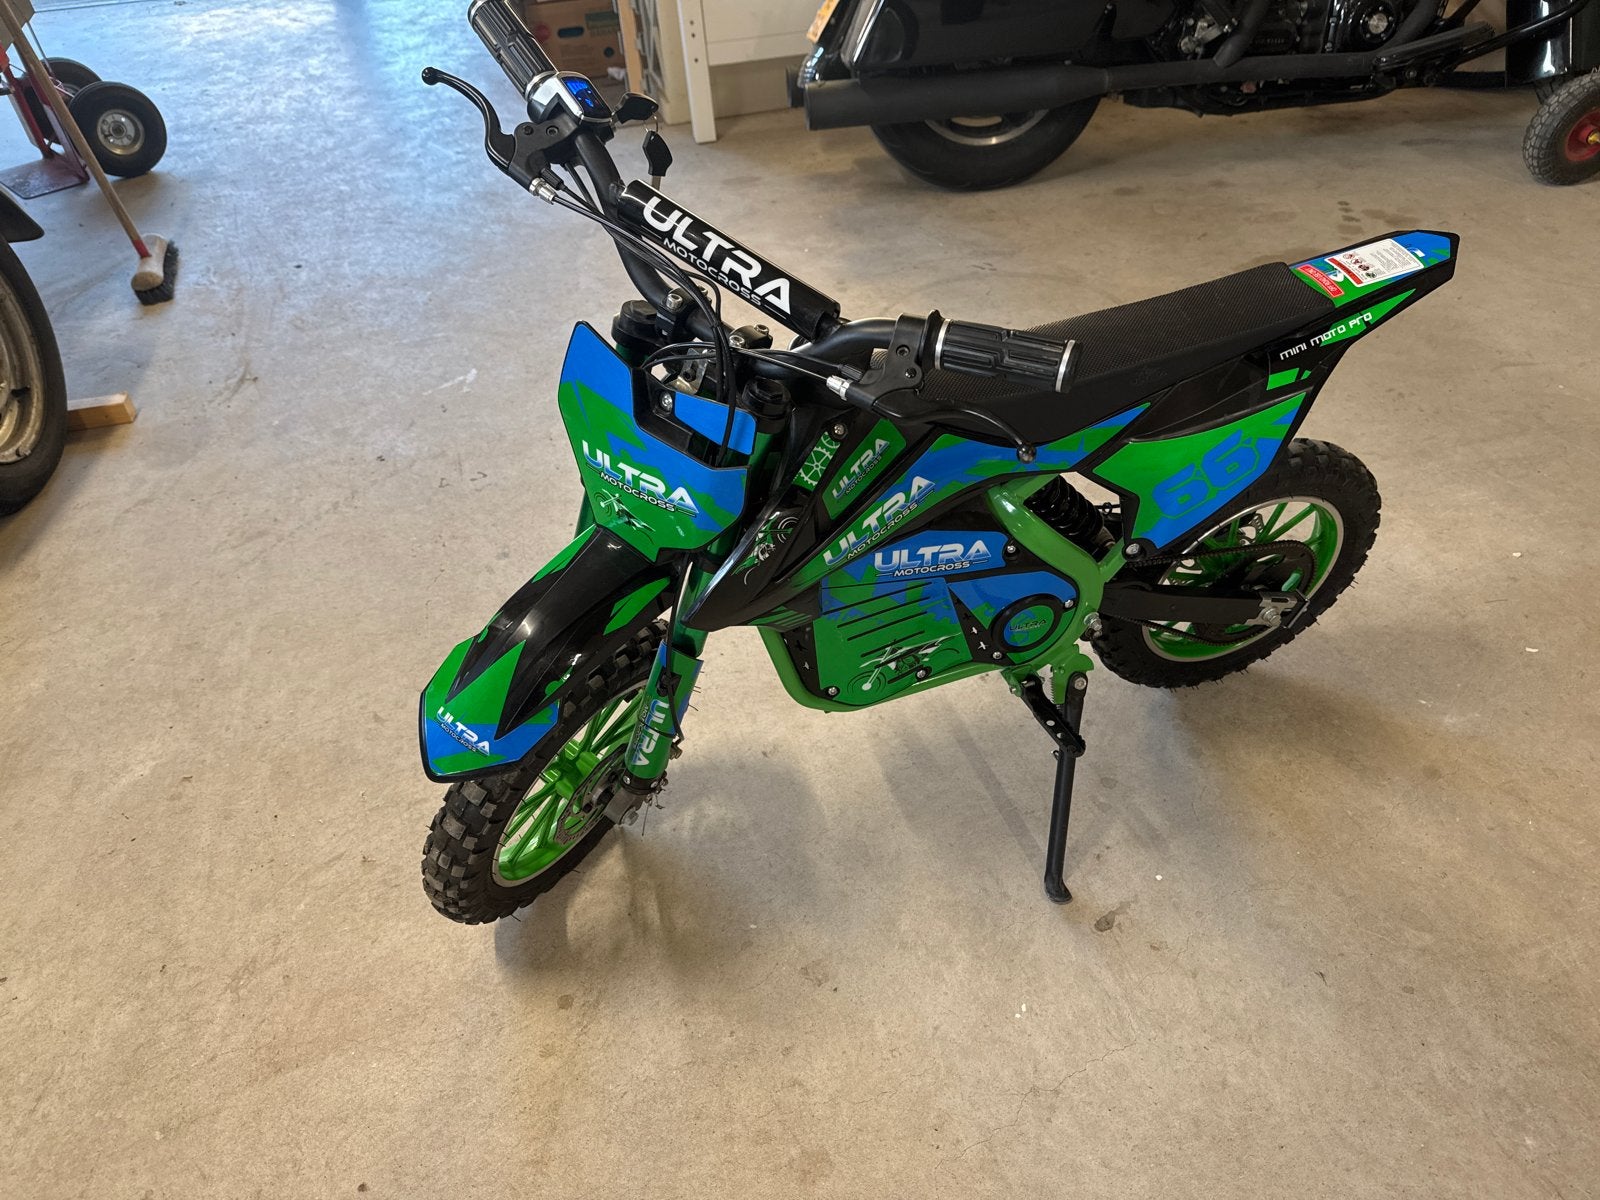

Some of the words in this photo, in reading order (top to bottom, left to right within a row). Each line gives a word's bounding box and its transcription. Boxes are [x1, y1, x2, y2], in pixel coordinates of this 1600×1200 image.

[643, 195, 791, 315] ULTRA
[663, 237, 762, 306] MOTOCROSS
[582, 439, 699, 514] ULTRA
[600, 471, 675, 512] MOTOCROSS
[831, 438, 890, 499] ULTRA
[845, 455, 882, 495] MOTOCROSS
[1152, 429, 1258, 518] 66
[822, 475, 936, 566] ULTRA
[846, 502, 919, 560] MOTOCROSS
[874, 539, 992, 572] ULTRA
[893, 561, 971, 577] MOTOCROSS
[436, 706, 490, 756] ULTRA
[441, 723, 477, 752] MOTOCROSS
[632, 699, 670, 766] ULTRA
